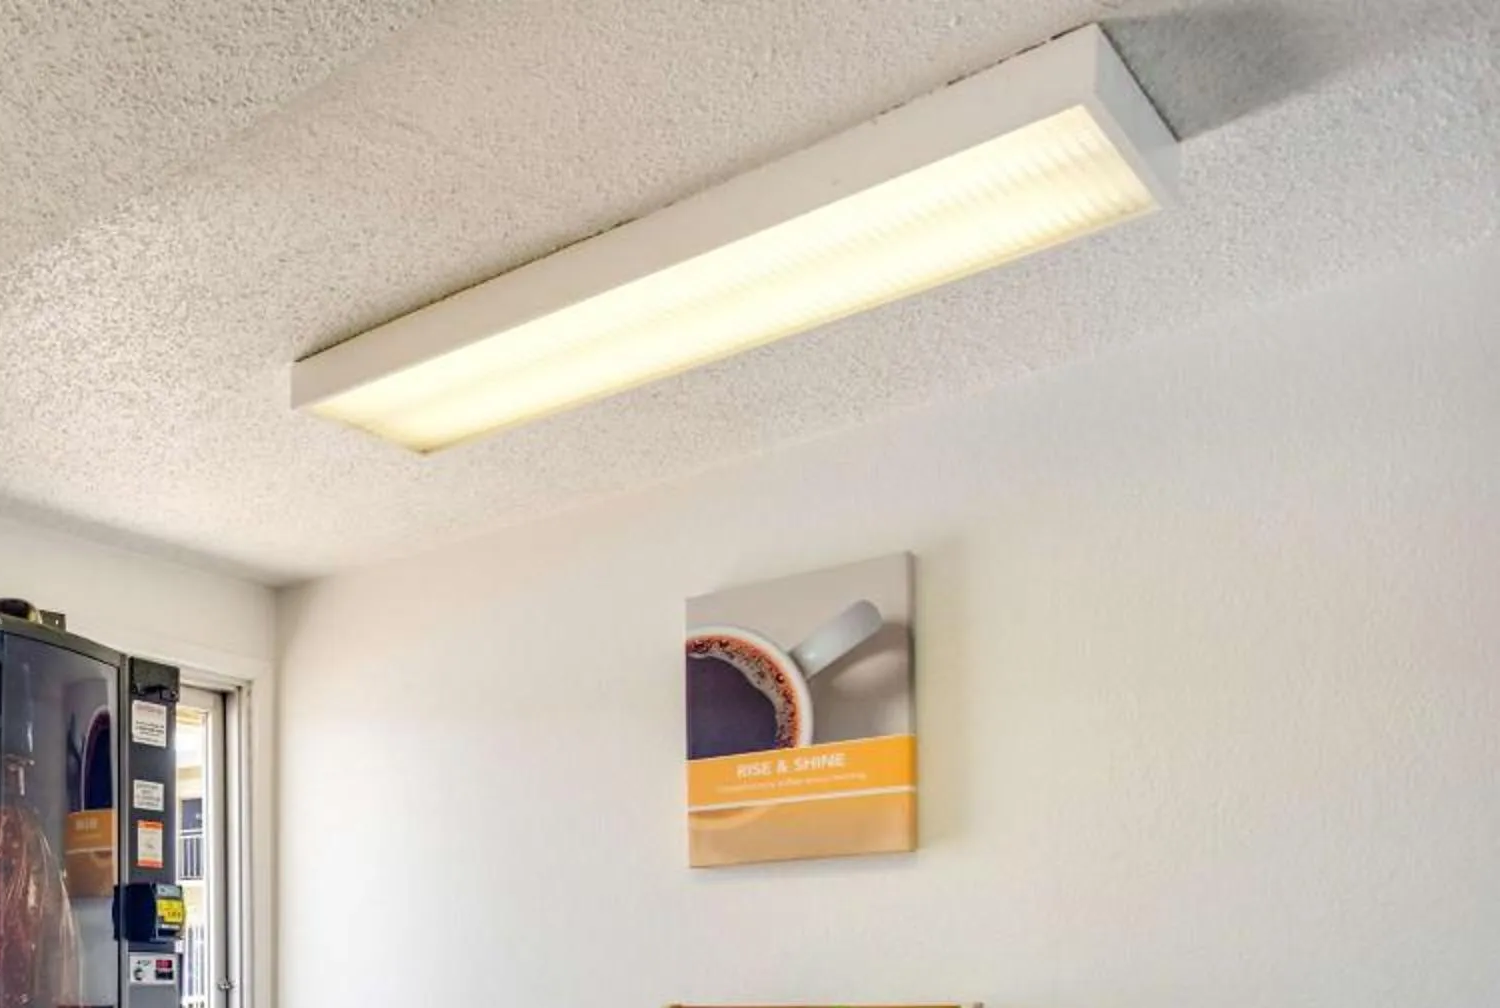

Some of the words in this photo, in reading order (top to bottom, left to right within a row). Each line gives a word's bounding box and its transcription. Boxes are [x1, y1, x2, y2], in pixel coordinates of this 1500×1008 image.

[736, 761, 772, 779] RISE
[777, 759, 788, 774] &
[794, 753, 846, 771] SHINE
